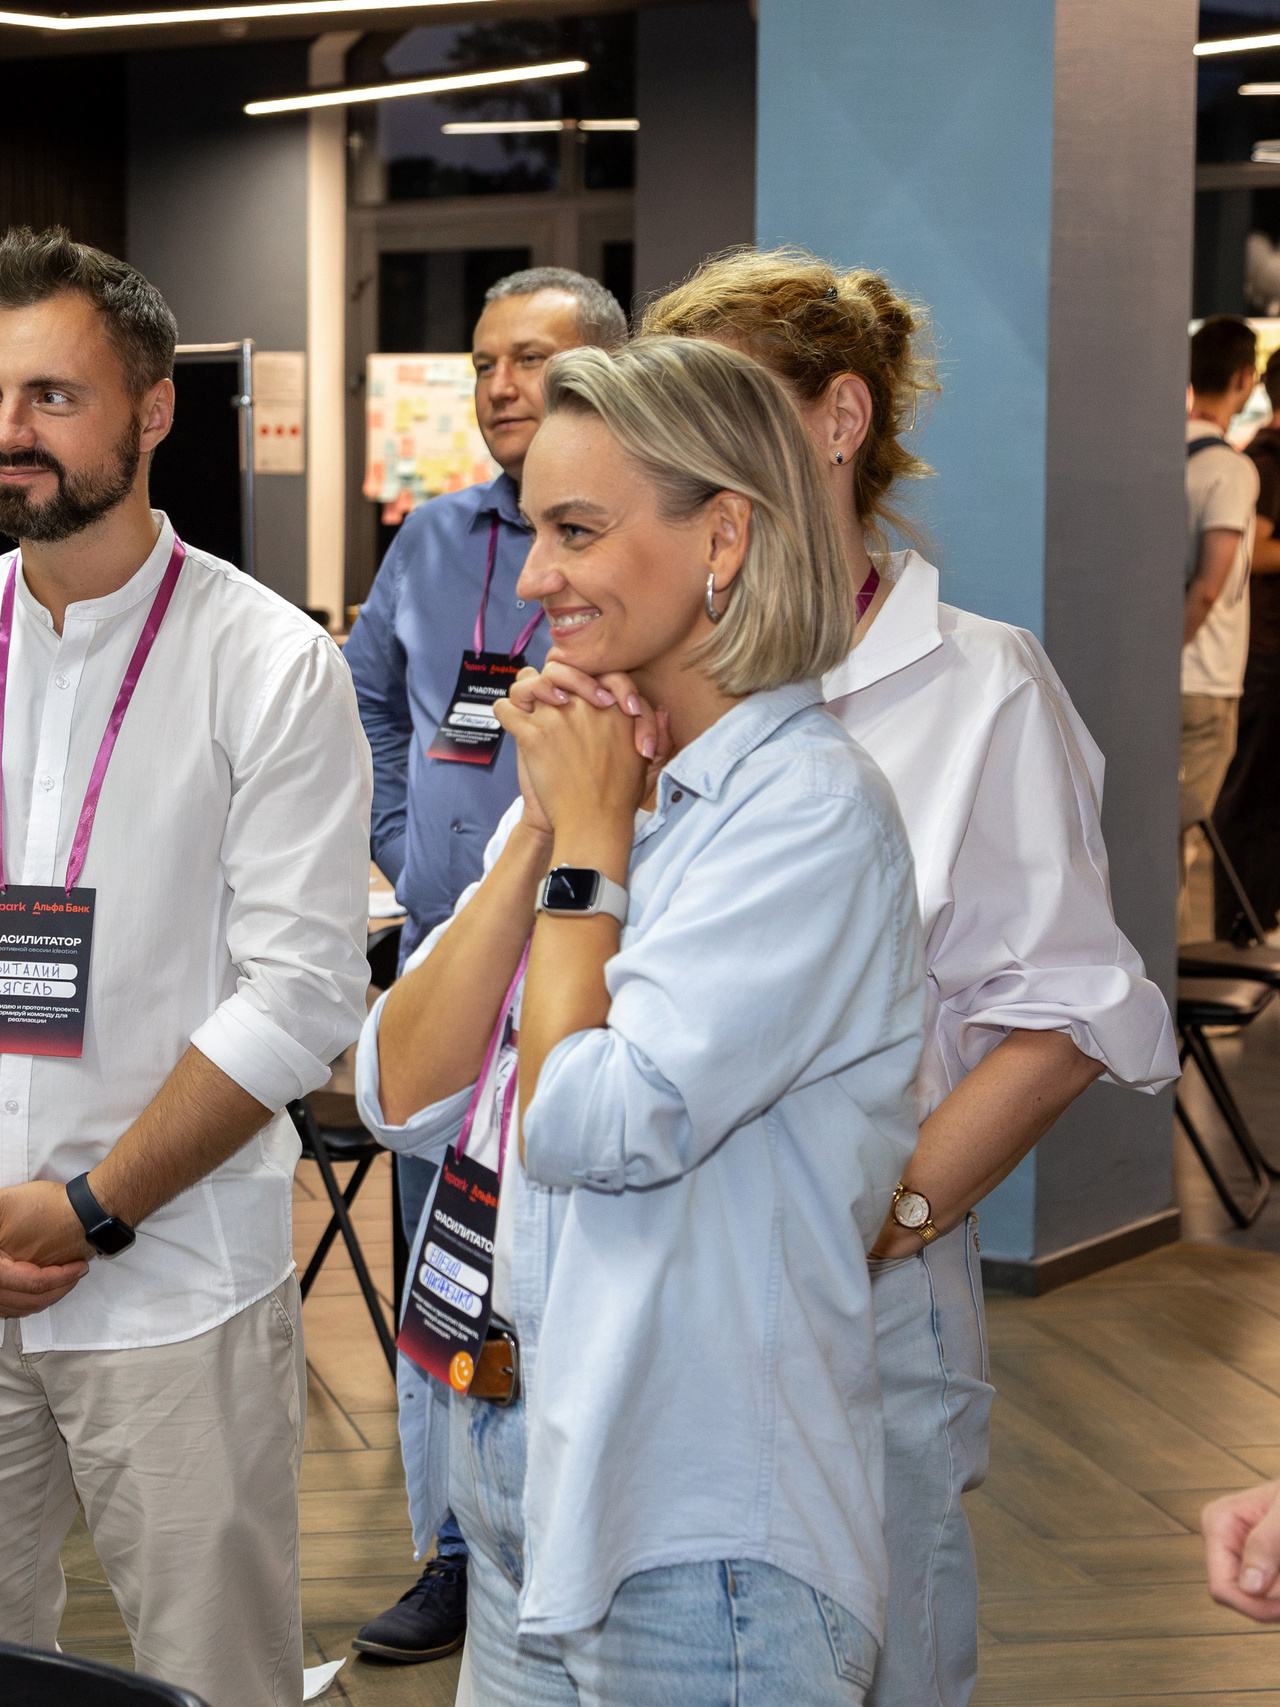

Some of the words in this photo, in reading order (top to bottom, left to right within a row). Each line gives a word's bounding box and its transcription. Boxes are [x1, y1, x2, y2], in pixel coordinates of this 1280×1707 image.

[32, 901, 65, 915] Альфа
[65, 903, 90, 914] Банк
[433, 1208, 495, 1255] ФАСИЛИТАТО
